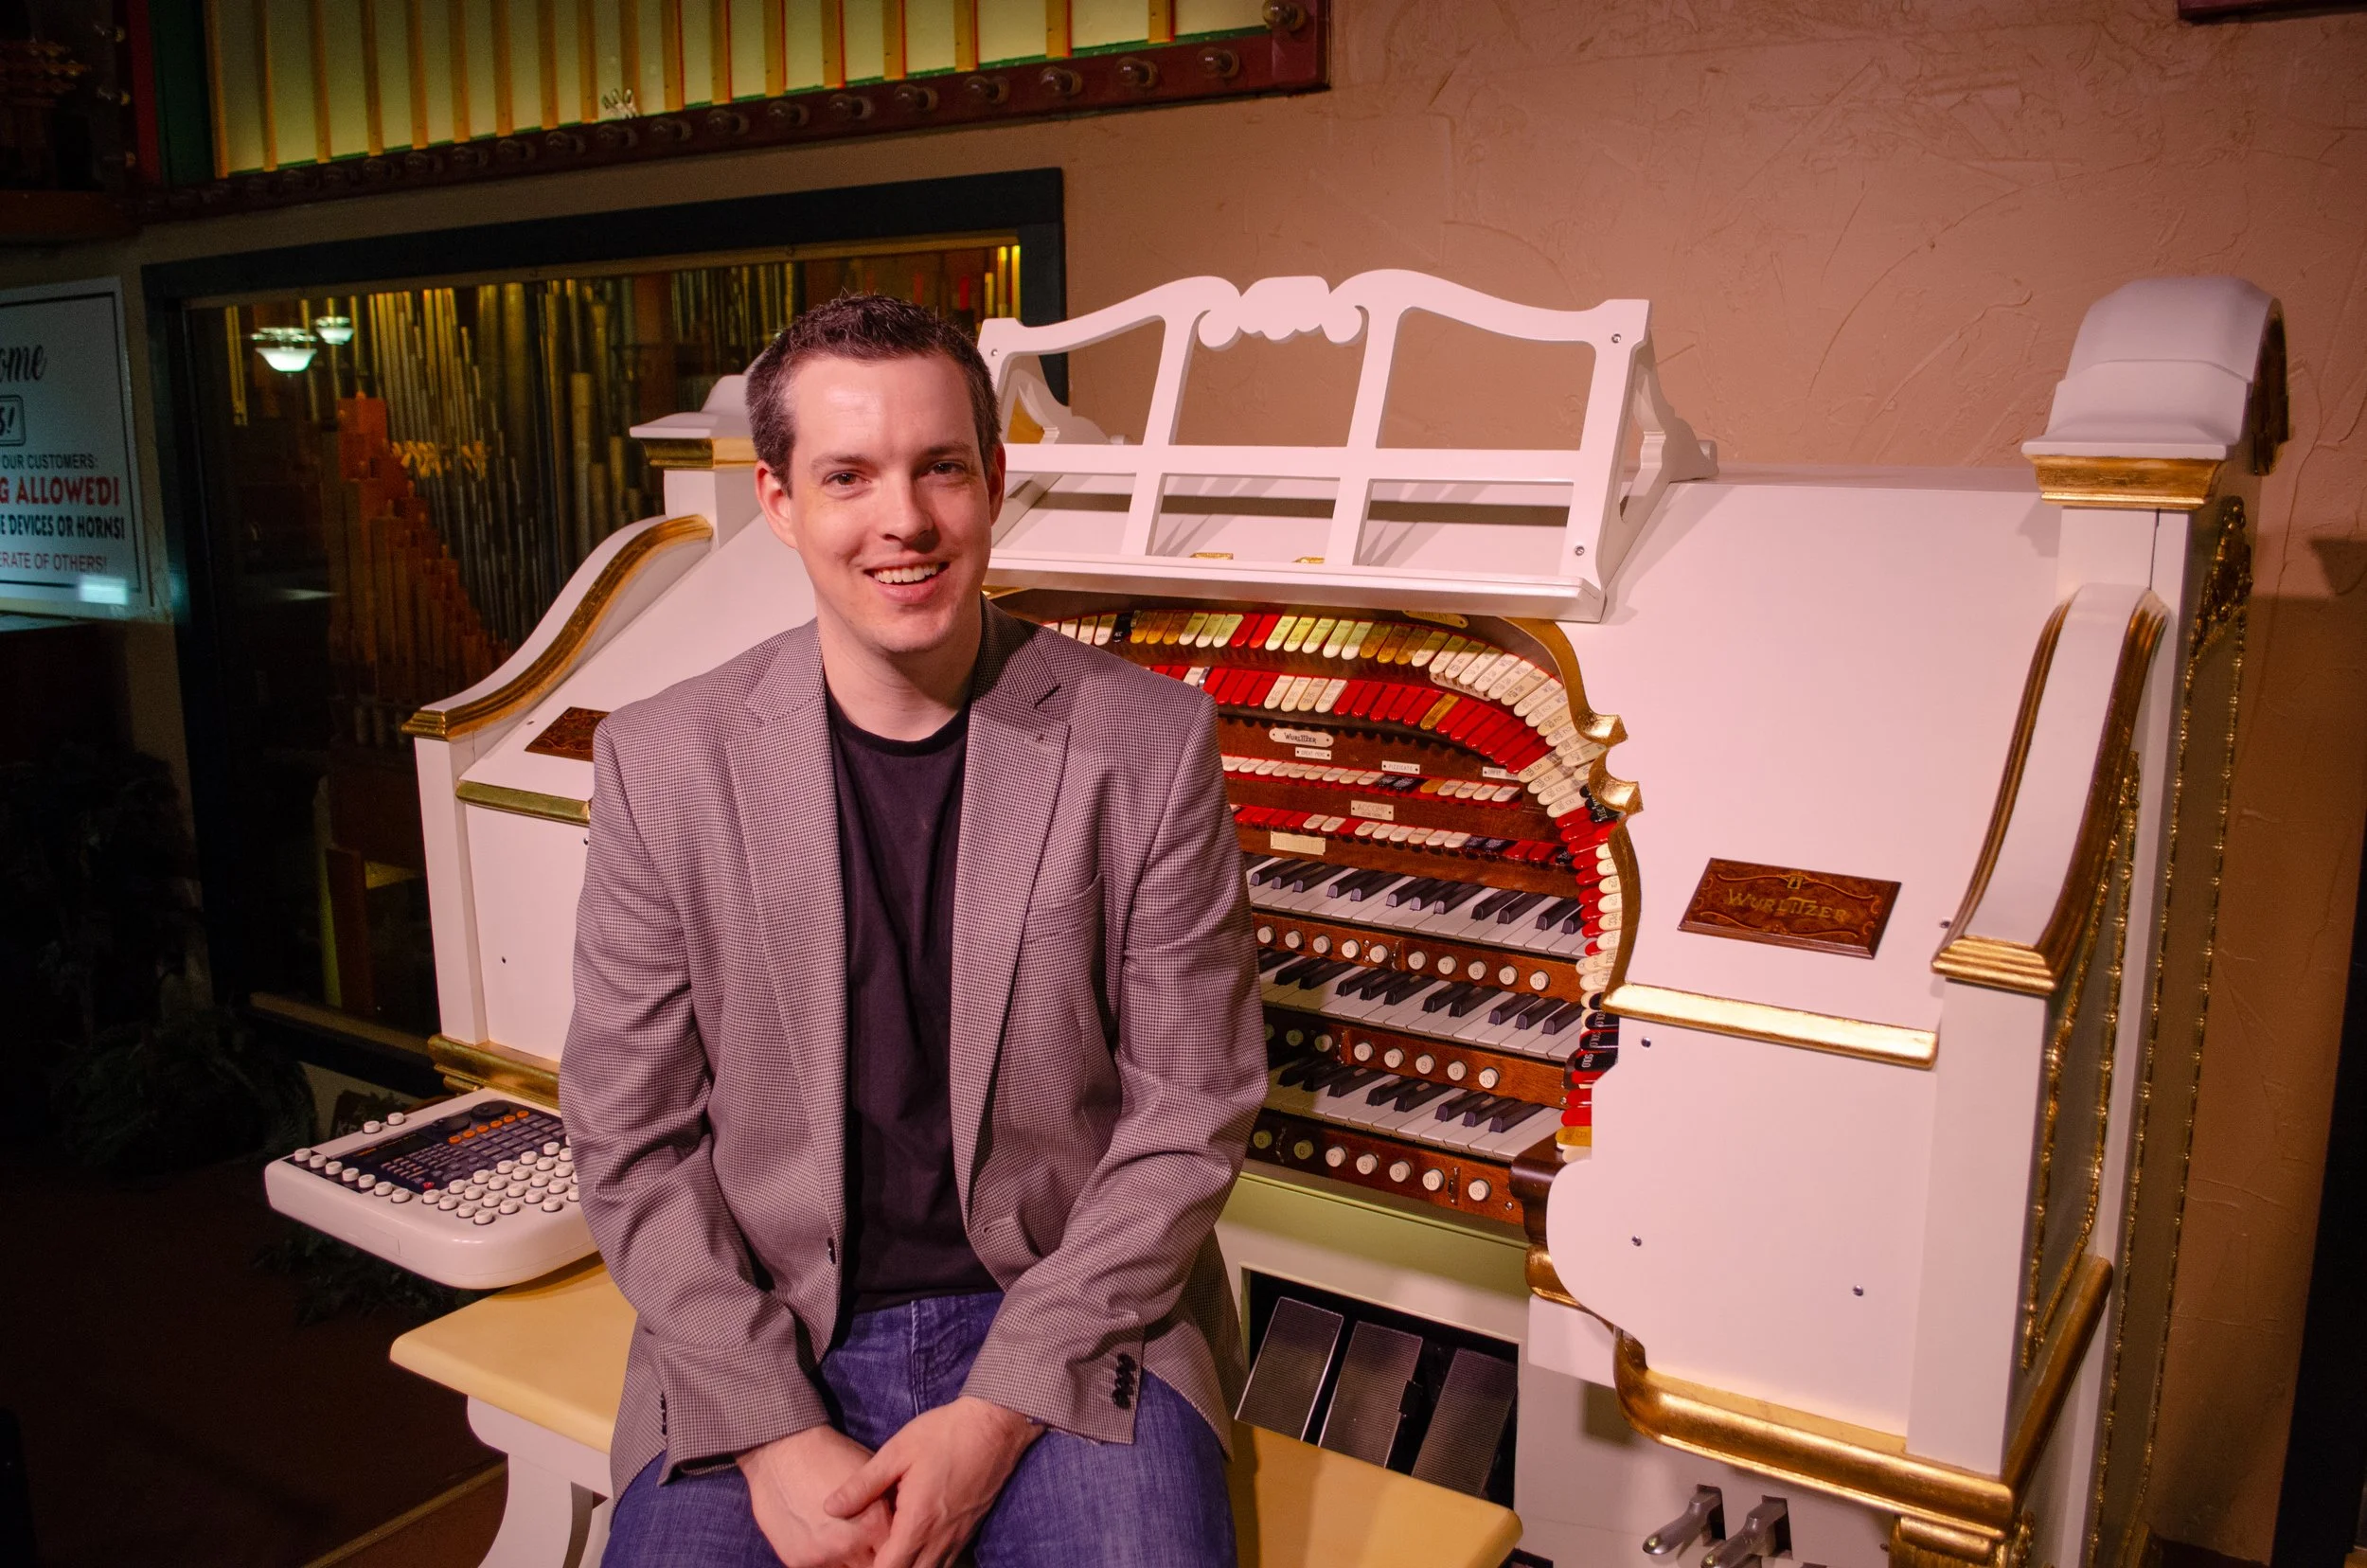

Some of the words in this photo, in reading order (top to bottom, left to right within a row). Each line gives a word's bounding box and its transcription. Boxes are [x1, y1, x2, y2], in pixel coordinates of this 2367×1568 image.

[2, 454, 25, 470] OUR
[16, 476, 120, 508] ALLOWED!
[8, 514, 54, 537] DEVICES
[58, 514, 74, 538] OR
[77, 515, 125, 541] HORNS!
[34, 553, 49, 570] OF
[1728, 888, 1847, 923] WURLITZER
[1581, 1053, 1594, 1068] SOLO
[1482, 1075, 1492, 1084] 10
[1425, 1176, 1437, 1186] 10
